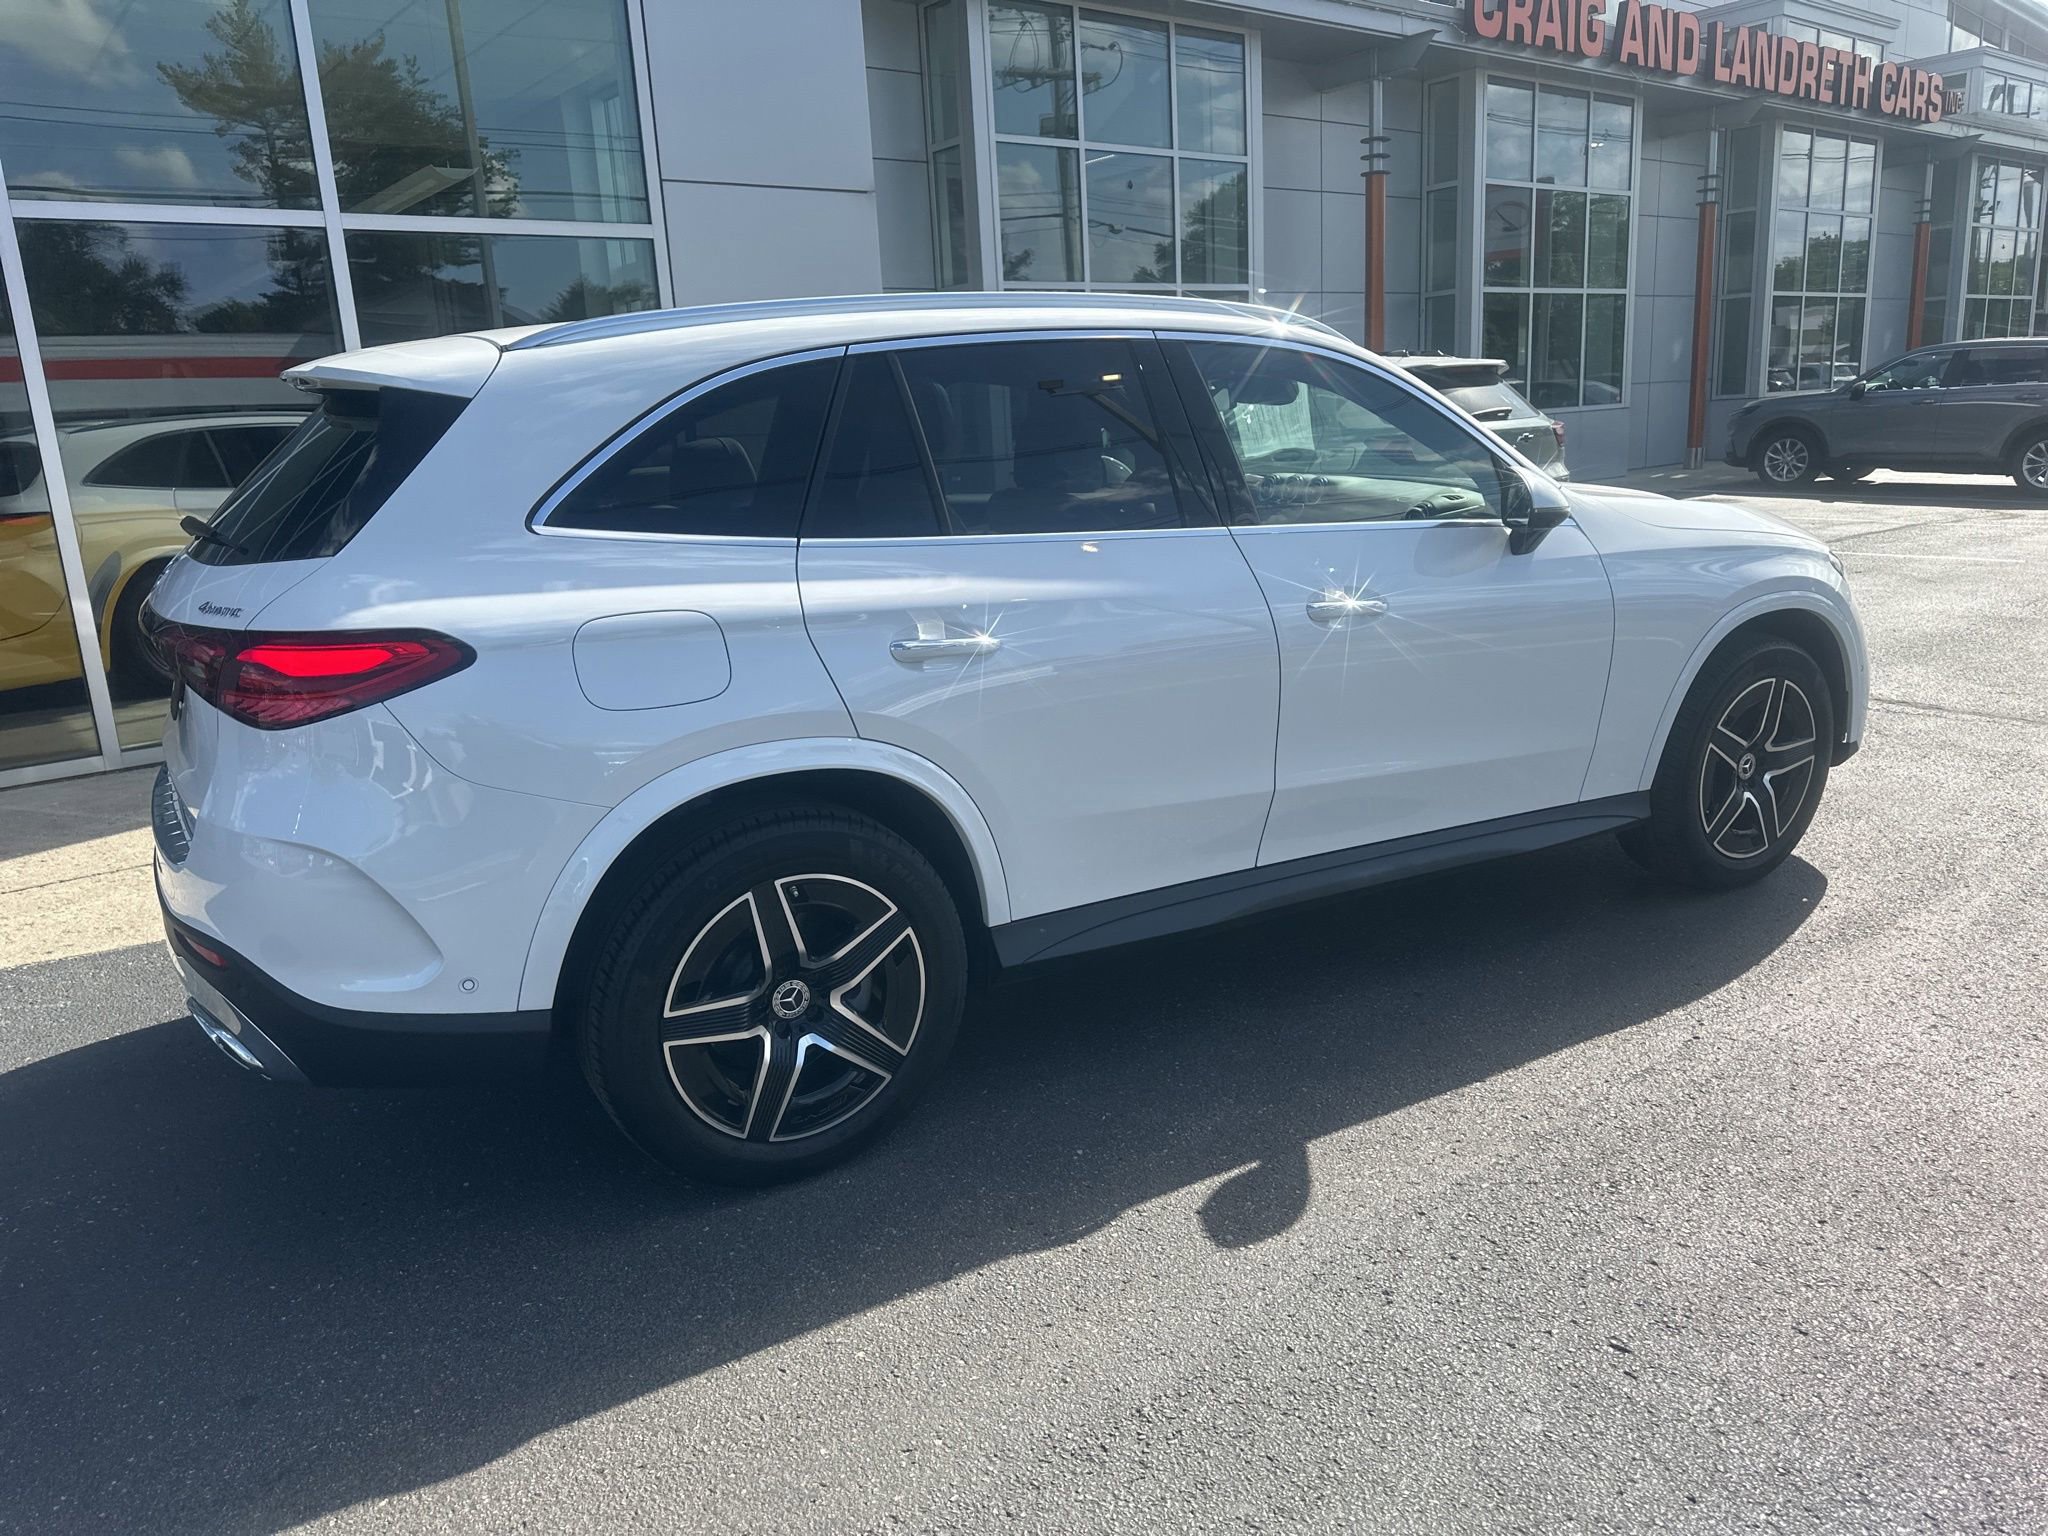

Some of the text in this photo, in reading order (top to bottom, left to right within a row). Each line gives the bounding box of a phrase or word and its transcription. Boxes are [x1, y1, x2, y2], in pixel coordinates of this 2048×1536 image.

[1618, 0, 1700, 76] AND
[1711, 20, 1872, 110] LANDRETH
[1879, 60, 1944, 124] CARS
